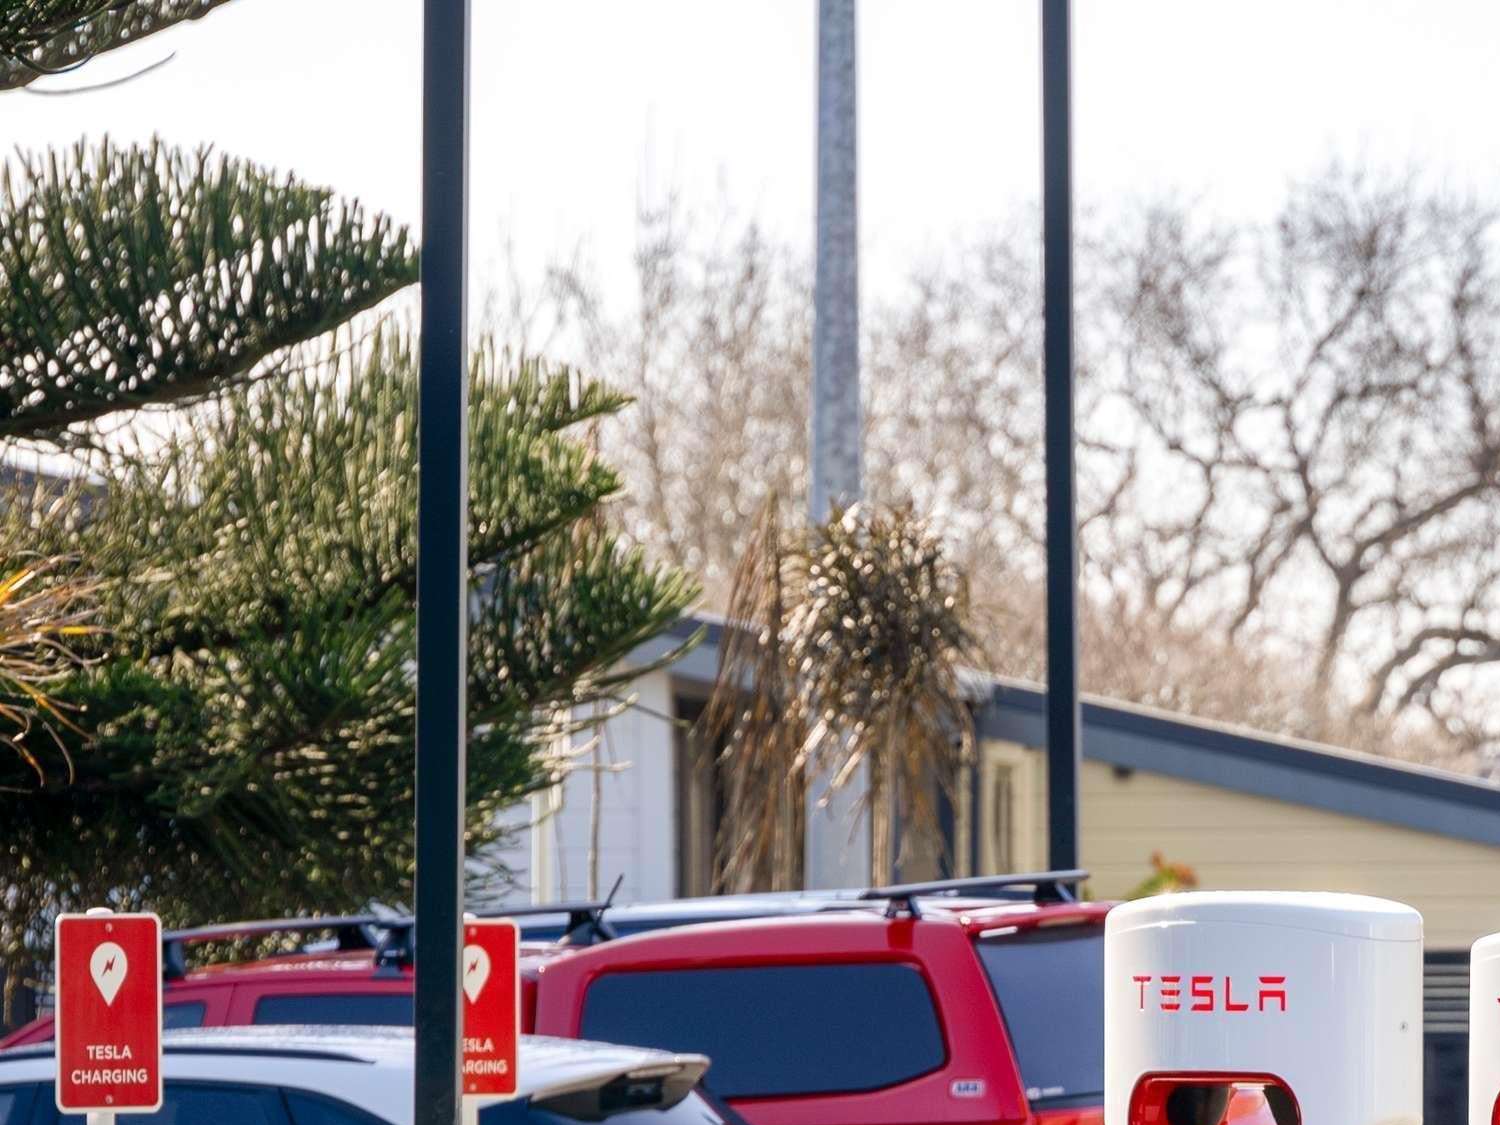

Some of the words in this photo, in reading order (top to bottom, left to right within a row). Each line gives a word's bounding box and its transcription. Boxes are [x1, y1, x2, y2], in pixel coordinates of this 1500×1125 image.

[1132, 976, 1286, 1011] TESLA
[86, 1044, 133, 1060] TESLA
[71, 1068, 148, 1085] CHARGING
